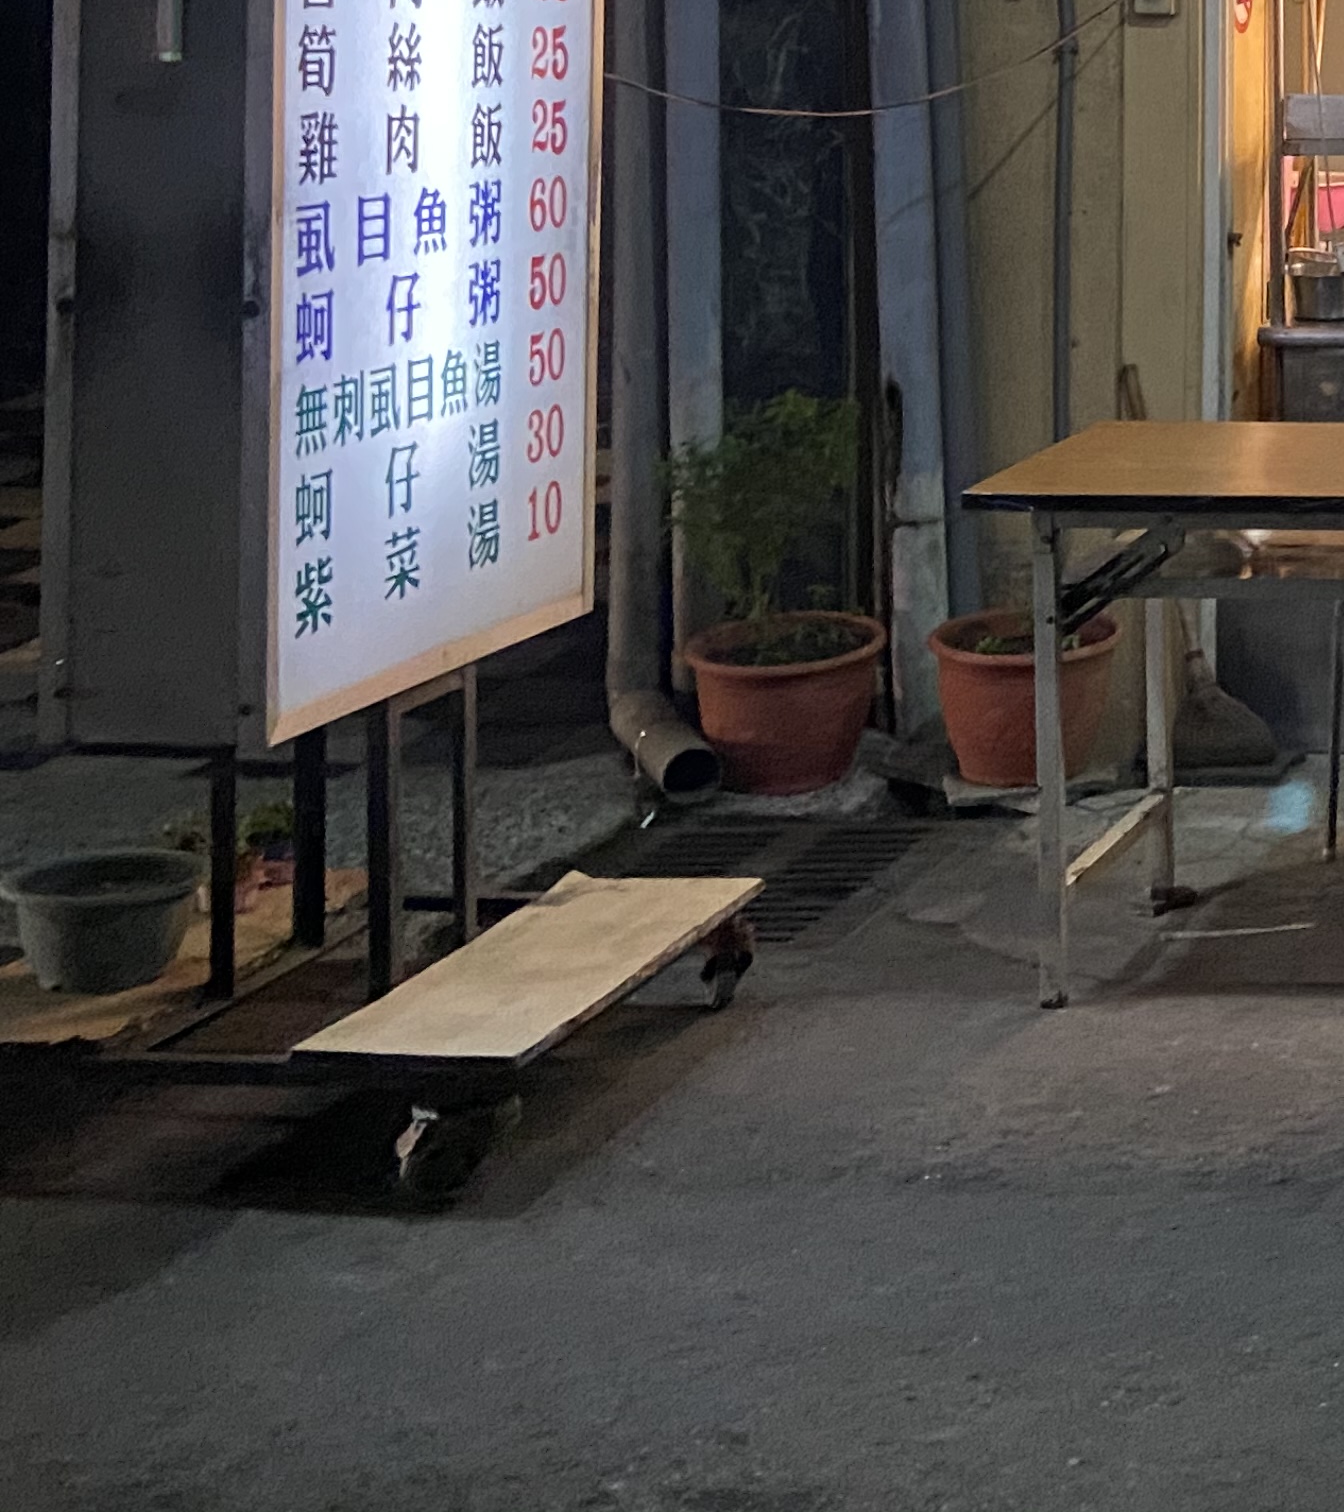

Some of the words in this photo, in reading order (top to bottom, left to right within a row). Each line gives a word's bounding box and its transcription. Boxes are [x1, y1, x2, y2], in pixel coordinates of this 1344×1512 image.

[299, 21, 503, 97] 筍絲飯
[531, 25, 569, 81] 25
[299, 101, 502, 186] 雞肉飯
[531, 99, 568, 155] 25
[528, 176, 567, 233] 60
[295, 258, 502, 365] 蚵仔粥
[528, 253, 566, 310] 50
[527, 328, 566, 386] 50
[295, 419, 501, 546] 蚵仔湯
[526, 403, 564, 464] 30
[294, 498, 501, 639] 紫菜湯
[526, 480, 562, 542] 10
